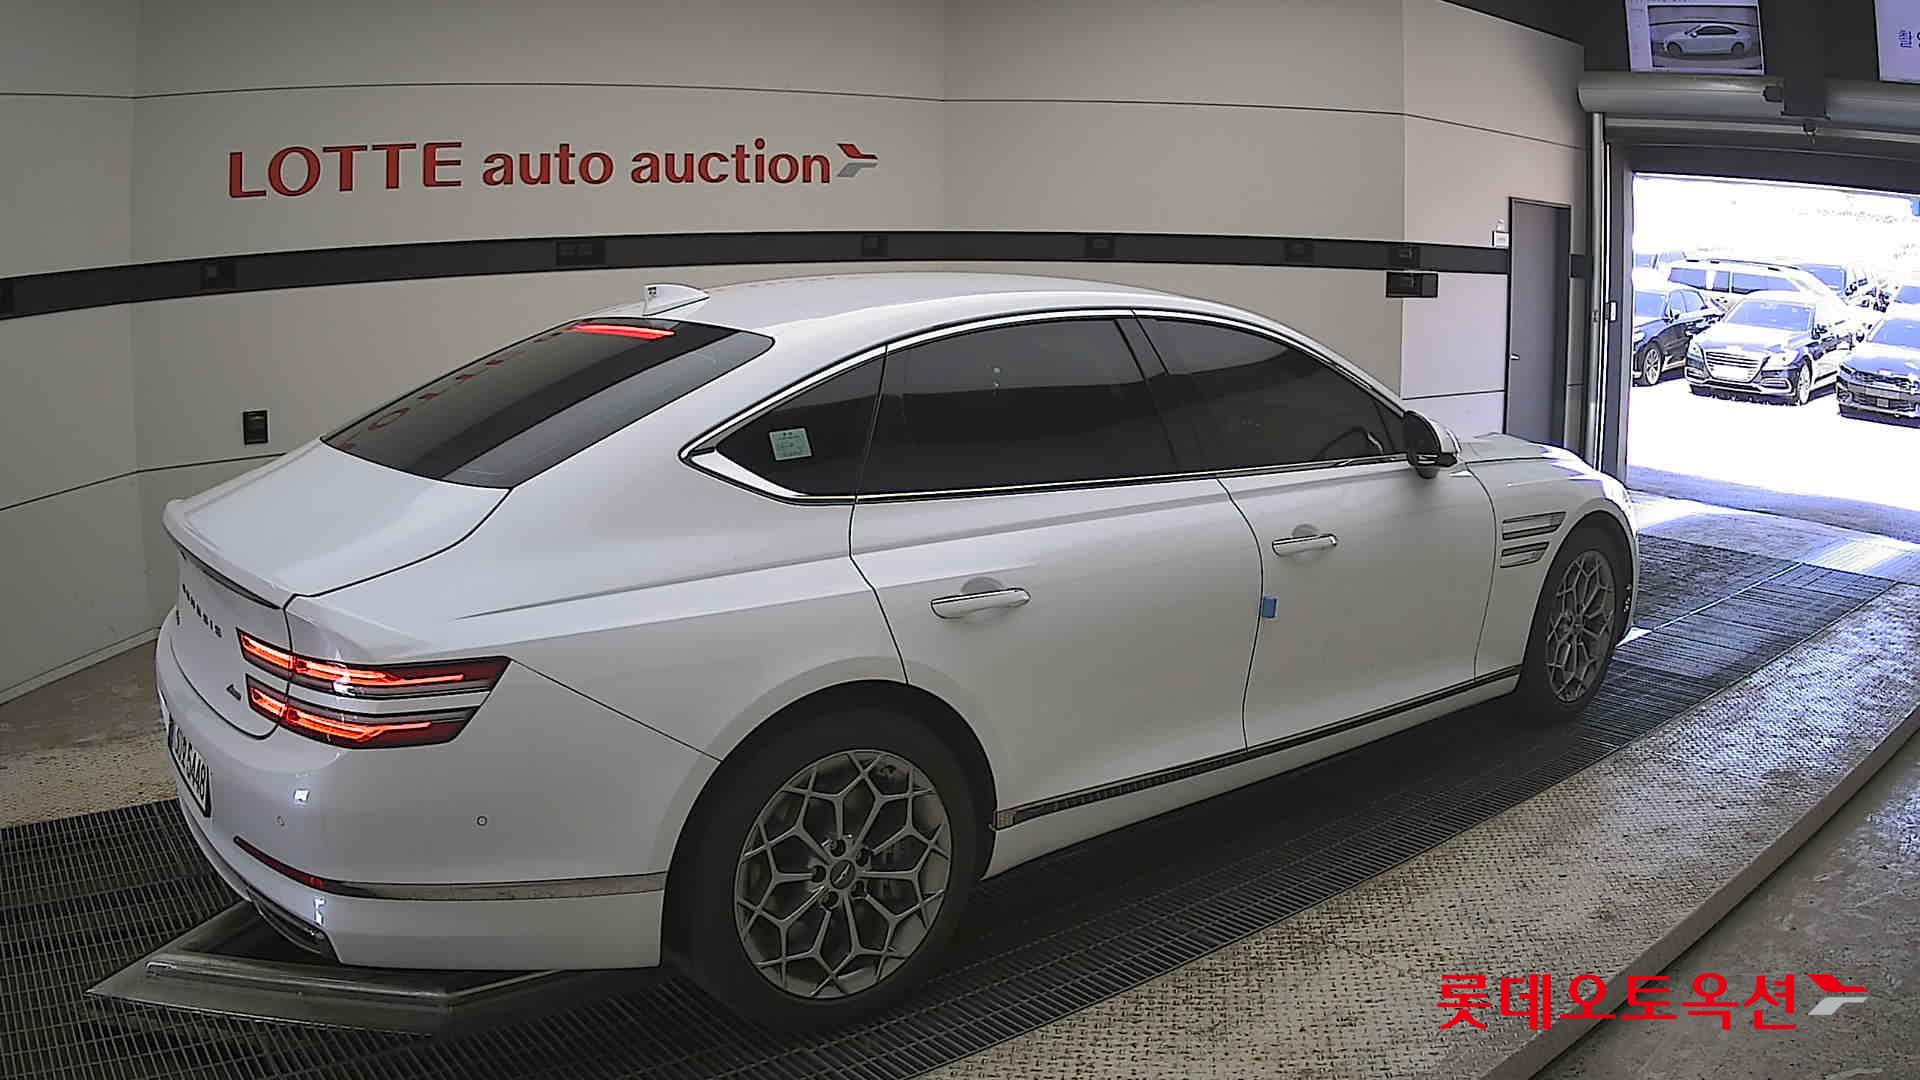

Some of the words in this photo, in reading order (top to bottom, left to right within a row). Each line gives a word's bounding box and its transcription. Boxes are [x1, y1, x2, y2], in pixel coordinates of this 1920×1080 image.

[1899, 30, 1920, 48] 촬
[229, 142, 462, 198] LOTTE
[482, 143, 615, 186] auto
[630, 138, 831, 185] auction
